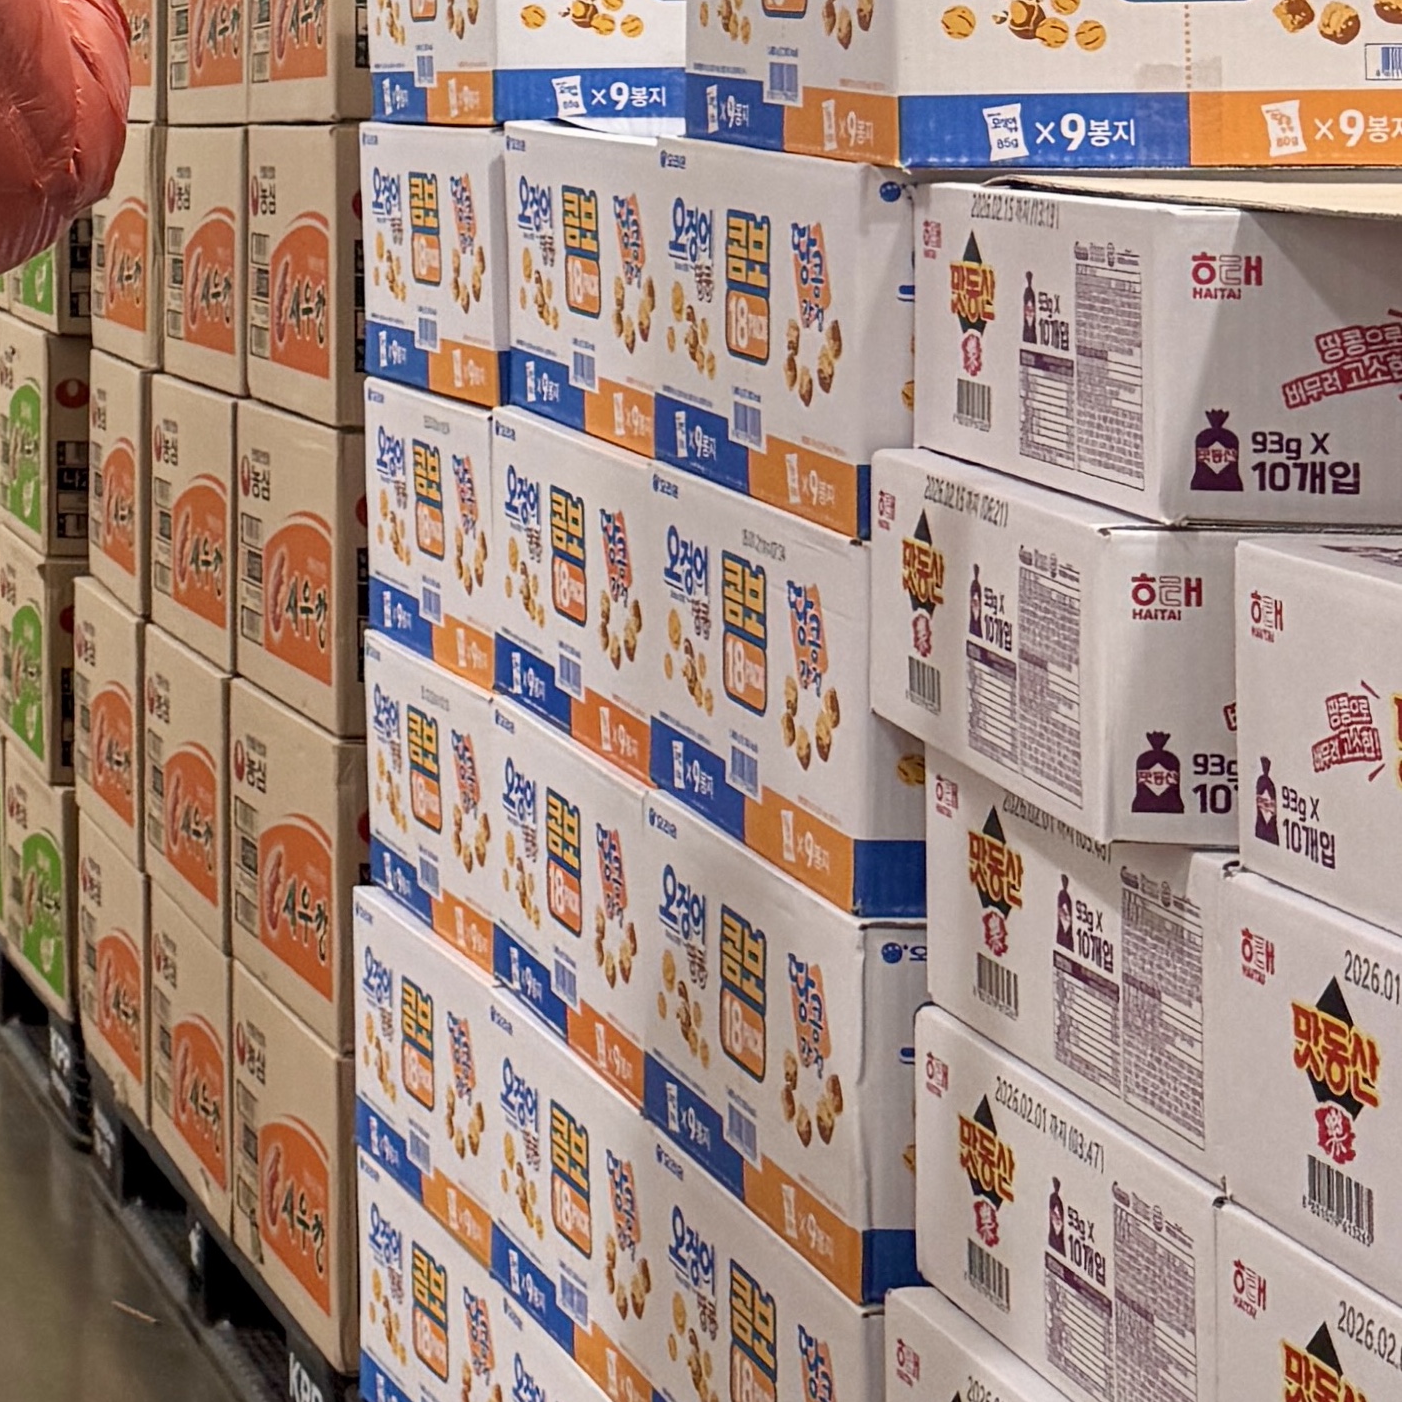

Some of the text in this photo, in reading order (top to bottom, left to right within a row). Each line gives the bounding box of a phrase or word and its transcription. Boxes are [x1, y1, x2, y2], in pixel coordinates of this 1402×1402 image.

[728, 210, 770, 290] 콤보
[288, 276, 327, 349] 새우깡
[1191, 287, 1242, 300] HAITAI
[1283, 372, 1343, 406] 버무려
[1251, 431, 1331, 460] 93g X
[1251, 460, 1361, 495] 10개입
[663, 524, 710, 597] 오징어
[284, 577, 328, 651] 새우깡
[722, 551, 767, 642] 콤보
[1132, 609, 1183, 621] HAITAI
[725, 636, 746, 696] 18
[1281, 785, 1320, 823] 93g X
[967, 828, 1025, 911] 맛동산
[1282, 817, 1336, 871] 10개입
[1075, 898, 1094, 933] 93g
[1075, 927, 1115, 974] 10개입
[1291, 1000, 1381, 1109] 맛동산
[995, 1075, 1048, 1134] 2026.02.01
[957, 1111, 1016, 1204] 맛동산
[1067, 1234, 1107, 1288] 10개입
